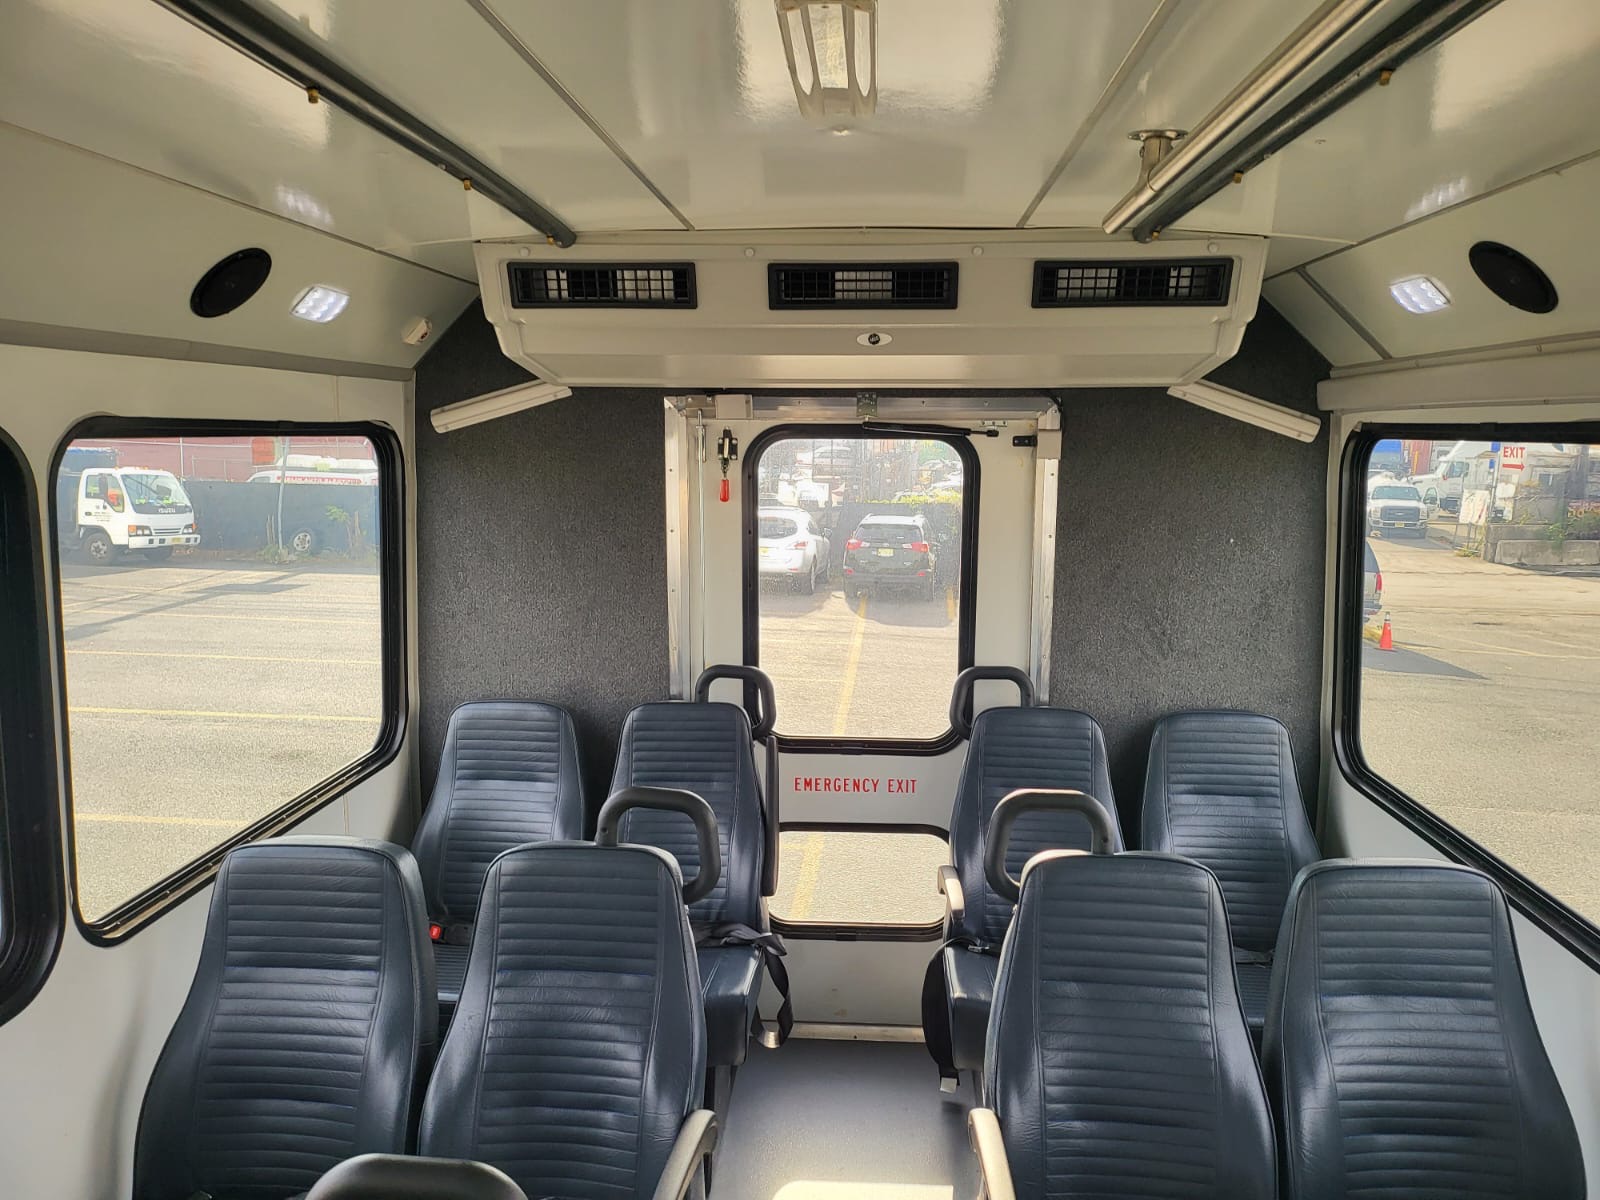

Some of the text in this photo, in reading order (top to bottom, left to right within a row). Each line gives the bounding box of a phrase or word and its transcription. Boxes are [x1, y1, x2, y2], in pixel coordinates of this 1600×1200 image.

[1503, 446, 1526, 458] EXIT
[794, 777, 918, 794] EMERGENCY EXIT
